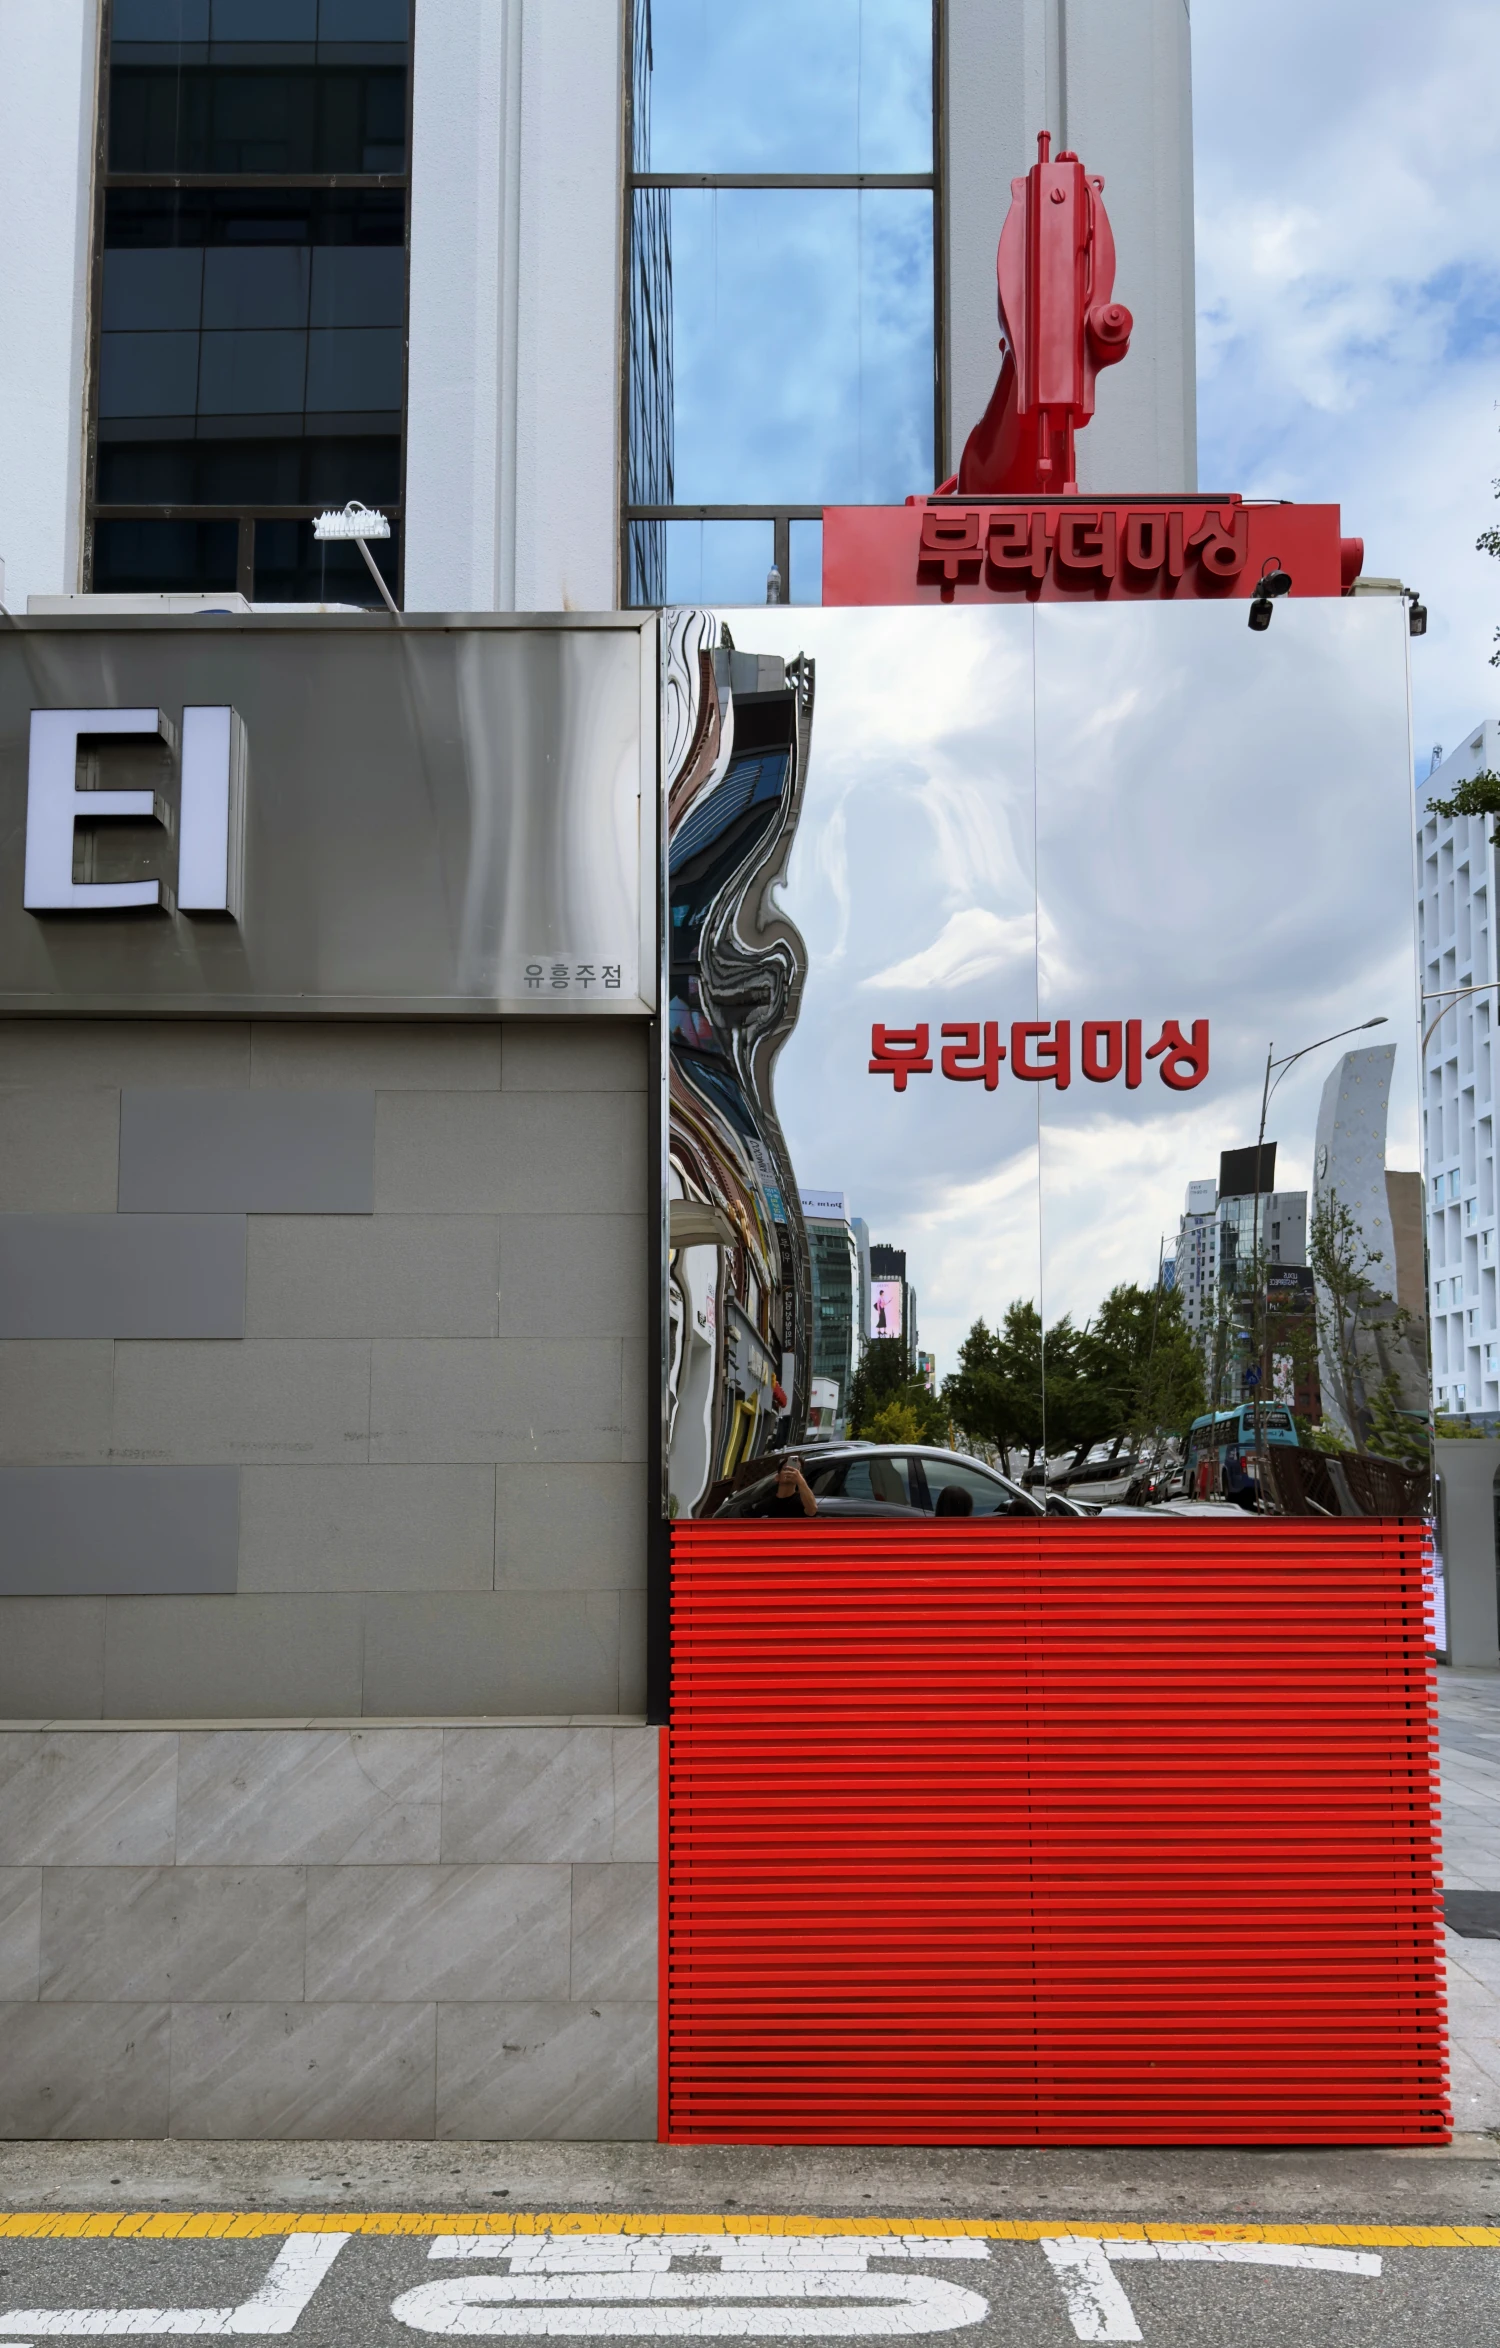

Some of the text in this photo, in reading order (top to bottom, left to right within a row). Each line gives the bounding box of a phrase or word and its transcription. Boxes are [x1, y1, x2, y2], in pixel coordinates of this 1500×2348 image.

[917, 510, 1250, 579] 부라더미싱
[23, 704, 242, 918] 티
[523, 963, 621, 989] 유흥주점
[867, 1018, 1210, 1092] 부라더미싱
